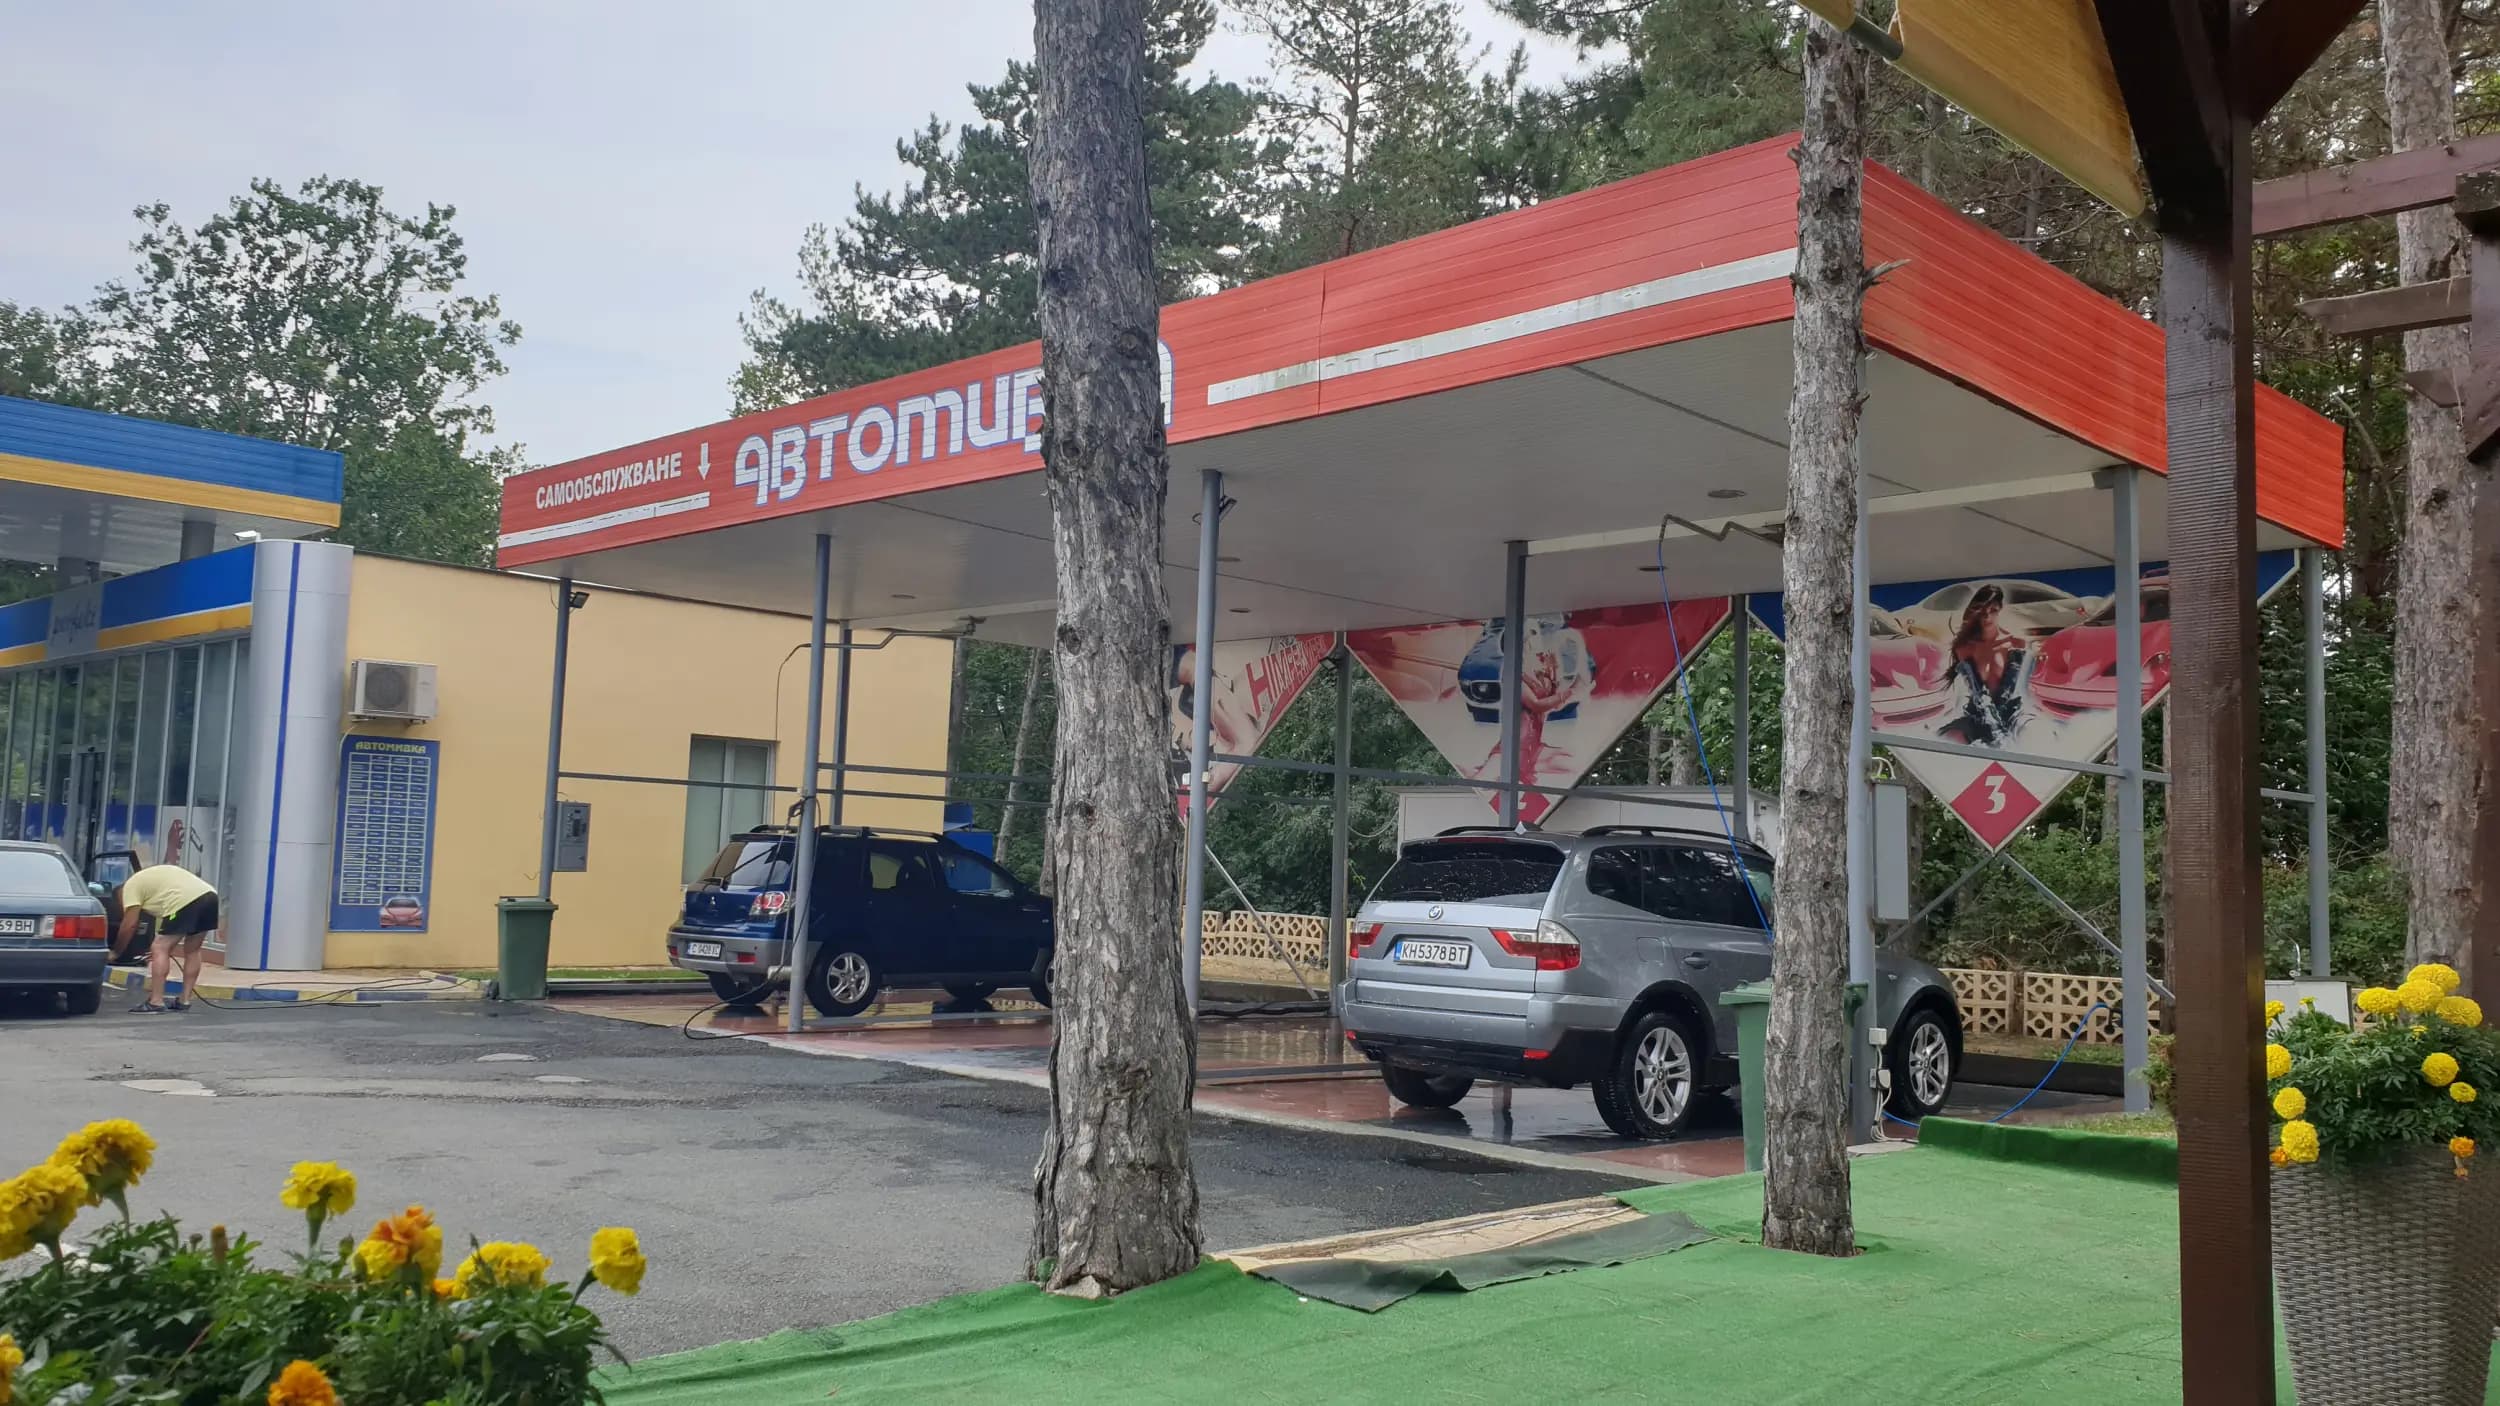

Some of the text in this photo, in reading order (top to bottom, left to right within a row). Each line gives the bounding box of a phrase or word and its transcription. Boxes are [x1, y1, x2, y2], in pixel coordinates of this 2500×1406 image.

[733, 340, 1175, 506] АВТОМИВ
[535, 451, 683, 510] САМООБСЛУЖВАНЕ
[355, 741, 427, 754] АВТОМИВКА
[1984, 775, 2008, 815] 3
